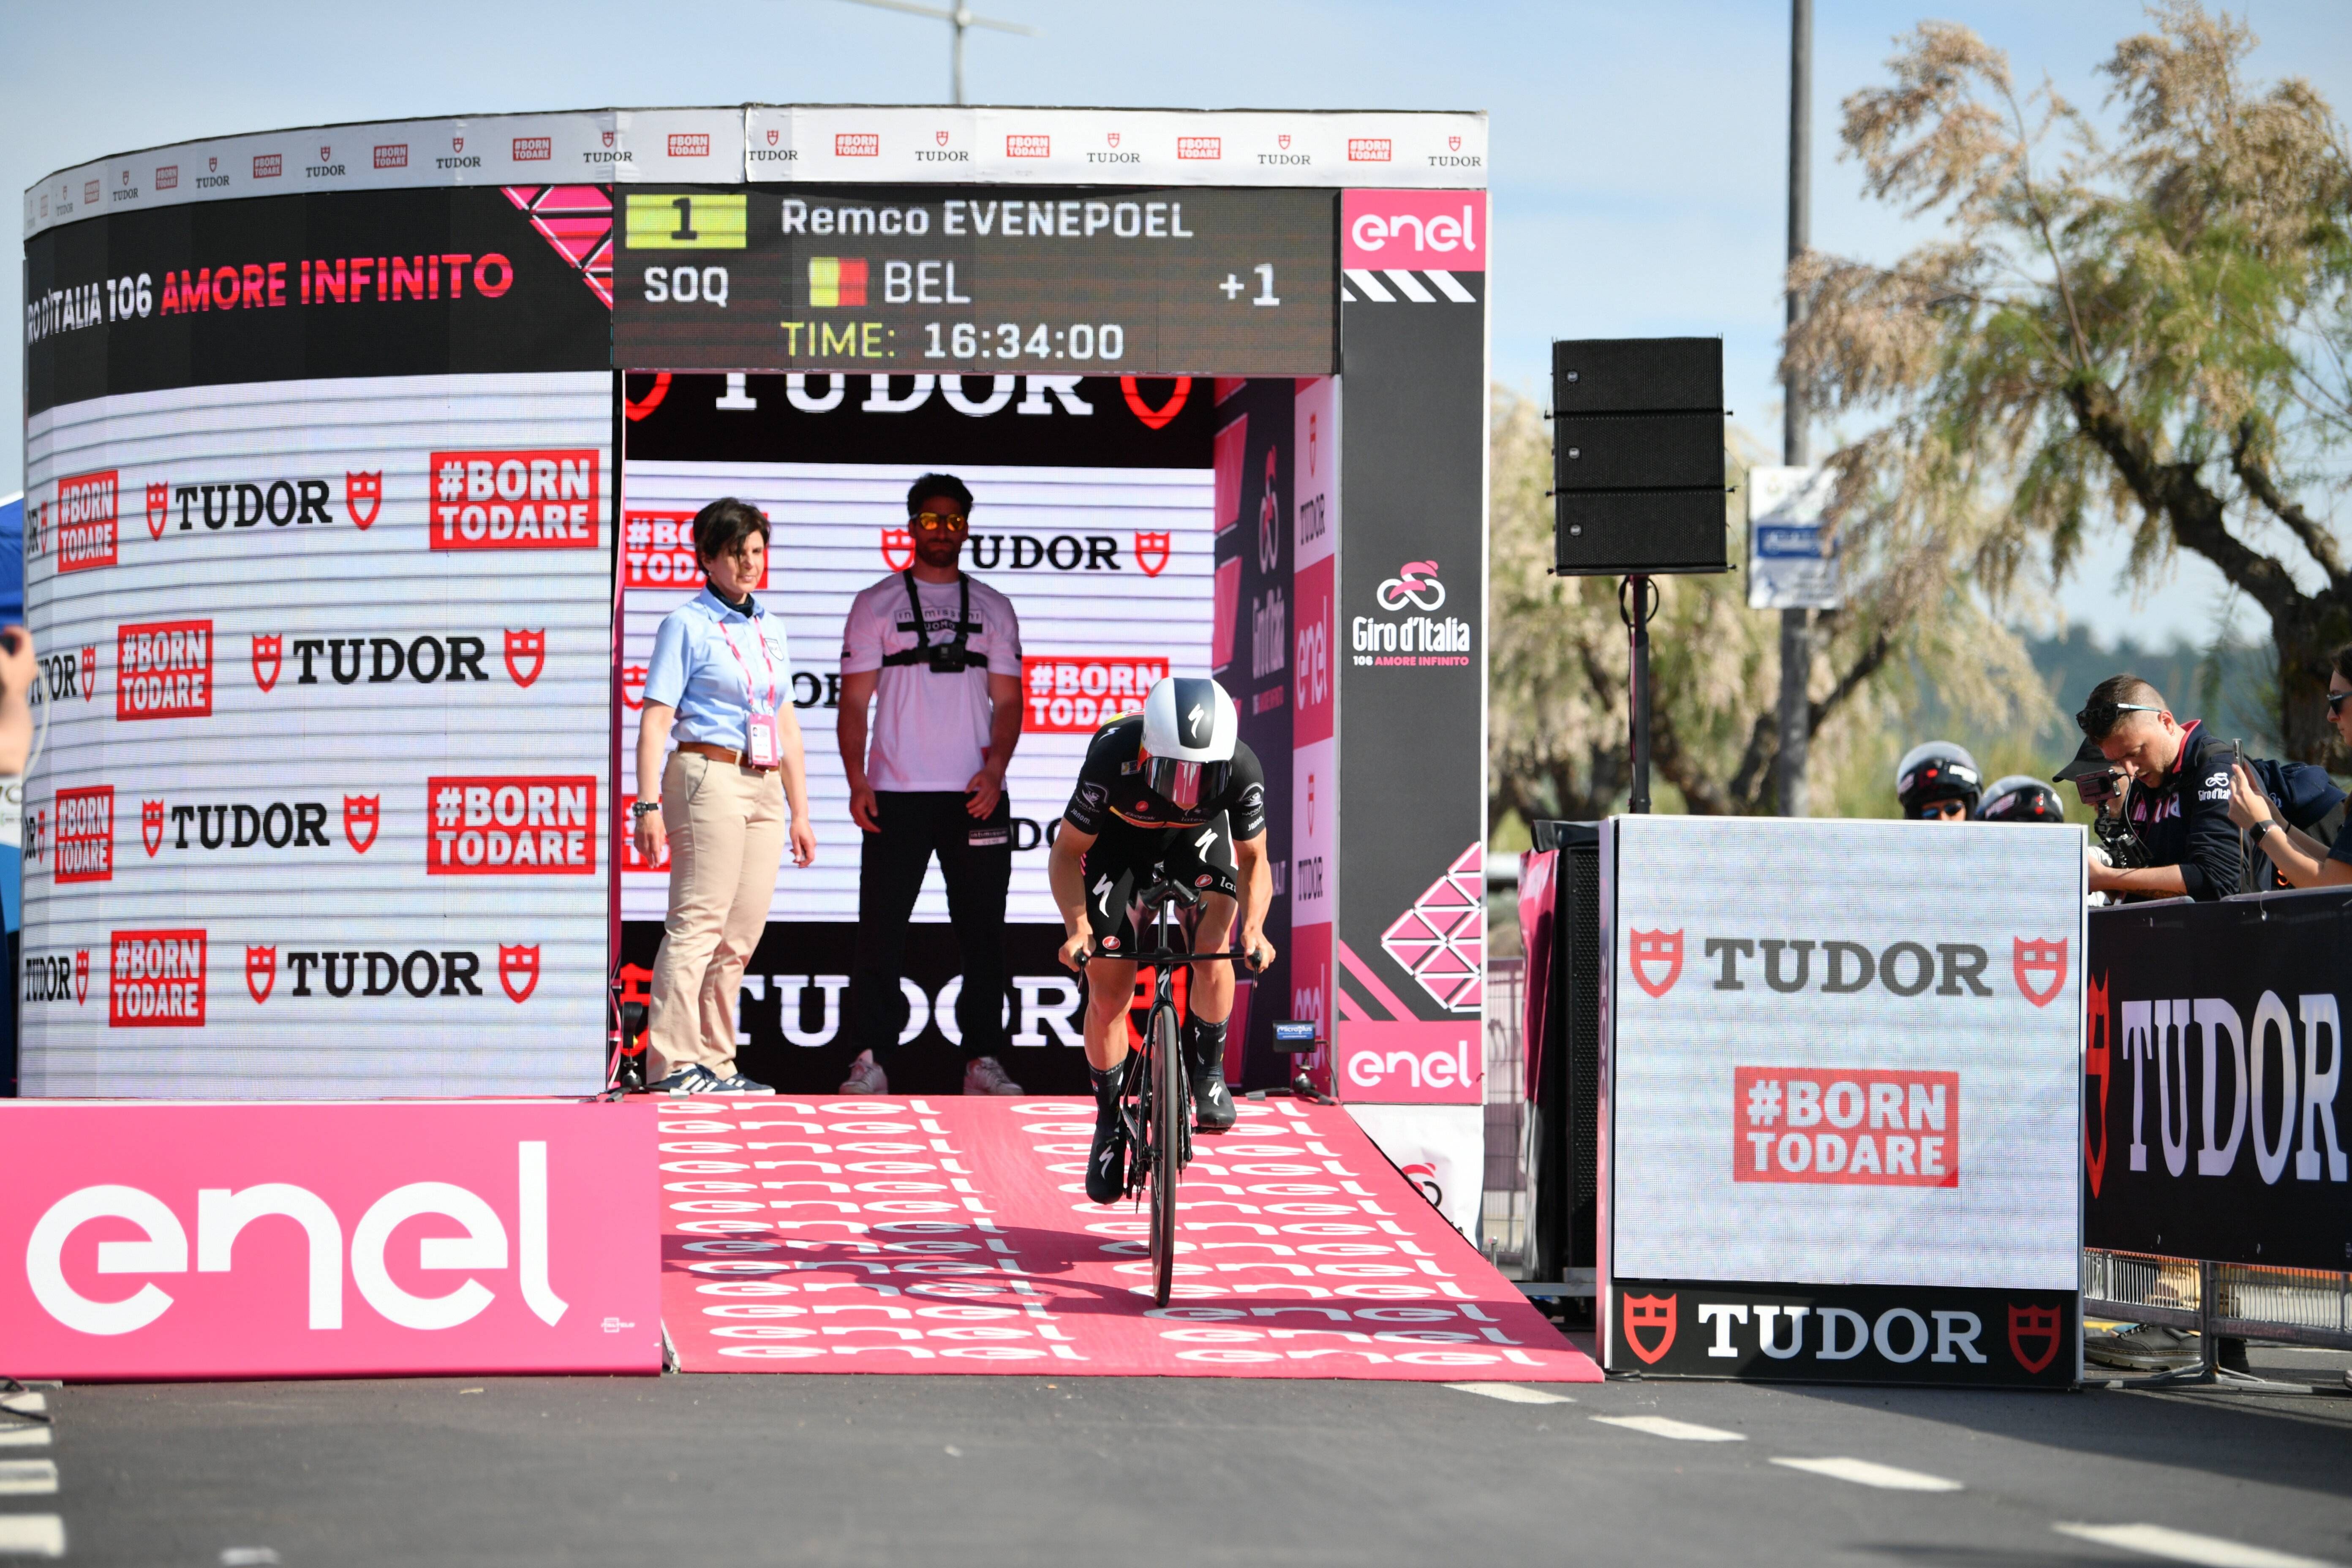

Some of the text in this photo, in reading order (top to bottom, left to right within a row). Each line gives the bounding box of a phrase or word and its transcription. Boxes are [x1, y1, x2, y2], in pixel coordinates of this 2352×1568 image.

[514, 139, 549, 150] #BORN
[670, 136, 708, 146] #BORN
[837, 135, 877, 146] #BORN
[837, 145, 877, 155] TODARE
[1009, 136, 1048, 147] #BORN
[1179, 139, 1219, 149] #BORN
[1350, 140, 1390, 150] #BORN
[376, 146, 406, 158] #BORN
[515, 149, 549, 159] TODARE
[584, 151, 633, 163] TUDOR
[670, 146, 708, 156] TODARE
[749, 150, 798, 161] TUDOR
[915, 151, 969, 162] TUDOR
[1009, 147, 1048, 156] TODARE
[1087, 152, 1140, 163] TUDOR
[1179, 149, 1219, 158] TODARE
[1258, 154, 1311, 165] TUDOR
[1350, 150, 1389, 160] TODARE
[255, 156, 280, 168] #BORN
[255, 166, 280, 177] TODARE
[306, 165, 346, 177] TUDOR
[376, 157, 406, 166] TODARE
[436, 157, 481, 169] TUDOR
[1428, 156, 1481, 167] TUDOR
[196, 175, 230, 188] TUDOR
[113, 188, 138, 201] TUDOR
[672, 197, 698, 240] 1
[781, 199, 1193, 237] Remco EVENEPOEL
[1352, 205, 1476, 251] enel
[644, 266, 729, 308] SOQ
[884, 260, 970, 304] BEL
[42, 283, 102, 339] D'ITALIA
[107, 272, 152, 322] 106
[161, 262, 286, 316] AMORE
[301, 252, 513, 305] INFINITO
[780, 322, 1124, 360] TIME: 16:34:00
[438, 459, 590, 502] #BORN
[61, 479, 113, 525] #BORN
[176, 480, 333, 530] TUDOR
[438, 505, 589, 540] TODARE
[1300, 493, 1326, 546] TUDOR
[61, 524, 113, 563] TODARE
[627, 518, 695, 552] #BO
[968, 535, 1121, 570] UDOR
[627, 553, 707, 582] TOD
[1353, 616, 1470, 652] Giro d'Italia
[122, 630, 206, 675] #BORN
[294, 636, 489, 685] TUDOR
[1297, 595, 1328, 710] enel
[1353, 656, 1469, 666] 106 AMORE INFINITO
[1029, 663, 1162, 696] #BORN
[122, 675, 206, 710] TODARE
[1029, 697, 1146, 726] TODA
[1075, 795, 1100, 813] NAPOLEON
[2198, 788, 2231, 801] Giro d'Ital
[436, 786, 588, 826] #BORN
[59, 796, 109, 838] #BORN
[172, 803, 330, 849] TUDOR
[1125, 812, 1156, 821] Ekopak
[59, 838, 108, 874] TODARE
[436, 830, 586, 866] TODARE
[1298, 857, 1323, 901] TUDOR
[116, 938, 200, 980] #BORN
[1704, 937, 1993, 997] TUDOR
[26, 957, 71, 1002] TUDOR
[288, 950, 482, 997] TUDOR
[115, 983, 199, 1017] TODARE
[1348, 1040, 1472, 1088] enel
[2121, 990, 2348, 1185] TUDOR
[659, 1100, 942, 1115] enel
[1748, 1079, 1946, 1130] #BORN
[659, 1119, 952, 1134] enel
[659, 1139, 963, 1154] enel
[1747, 1132, 1944, 1176] TODARE
[659, 1159, 973, 1174] enel
[663, 1179, 984, 1193] enel
[669, 1198, 996, 1213] enel
[676, 1218, 1008, 1233] enel
[26, 1141, 569, 1335] enel
[682, 1239, 1021, 1254] enel
[688, 1259, 1034, 1274] enel
[695, 1280, 1054, 1296] enel
[702, 1303, 1501, 1322] enel enel
[709, 1325, 1524, 1345] enel enel
[1698, 1304, 1987, 1364] TUDOR
[718, 1345, 1547, 1367] enel enel
